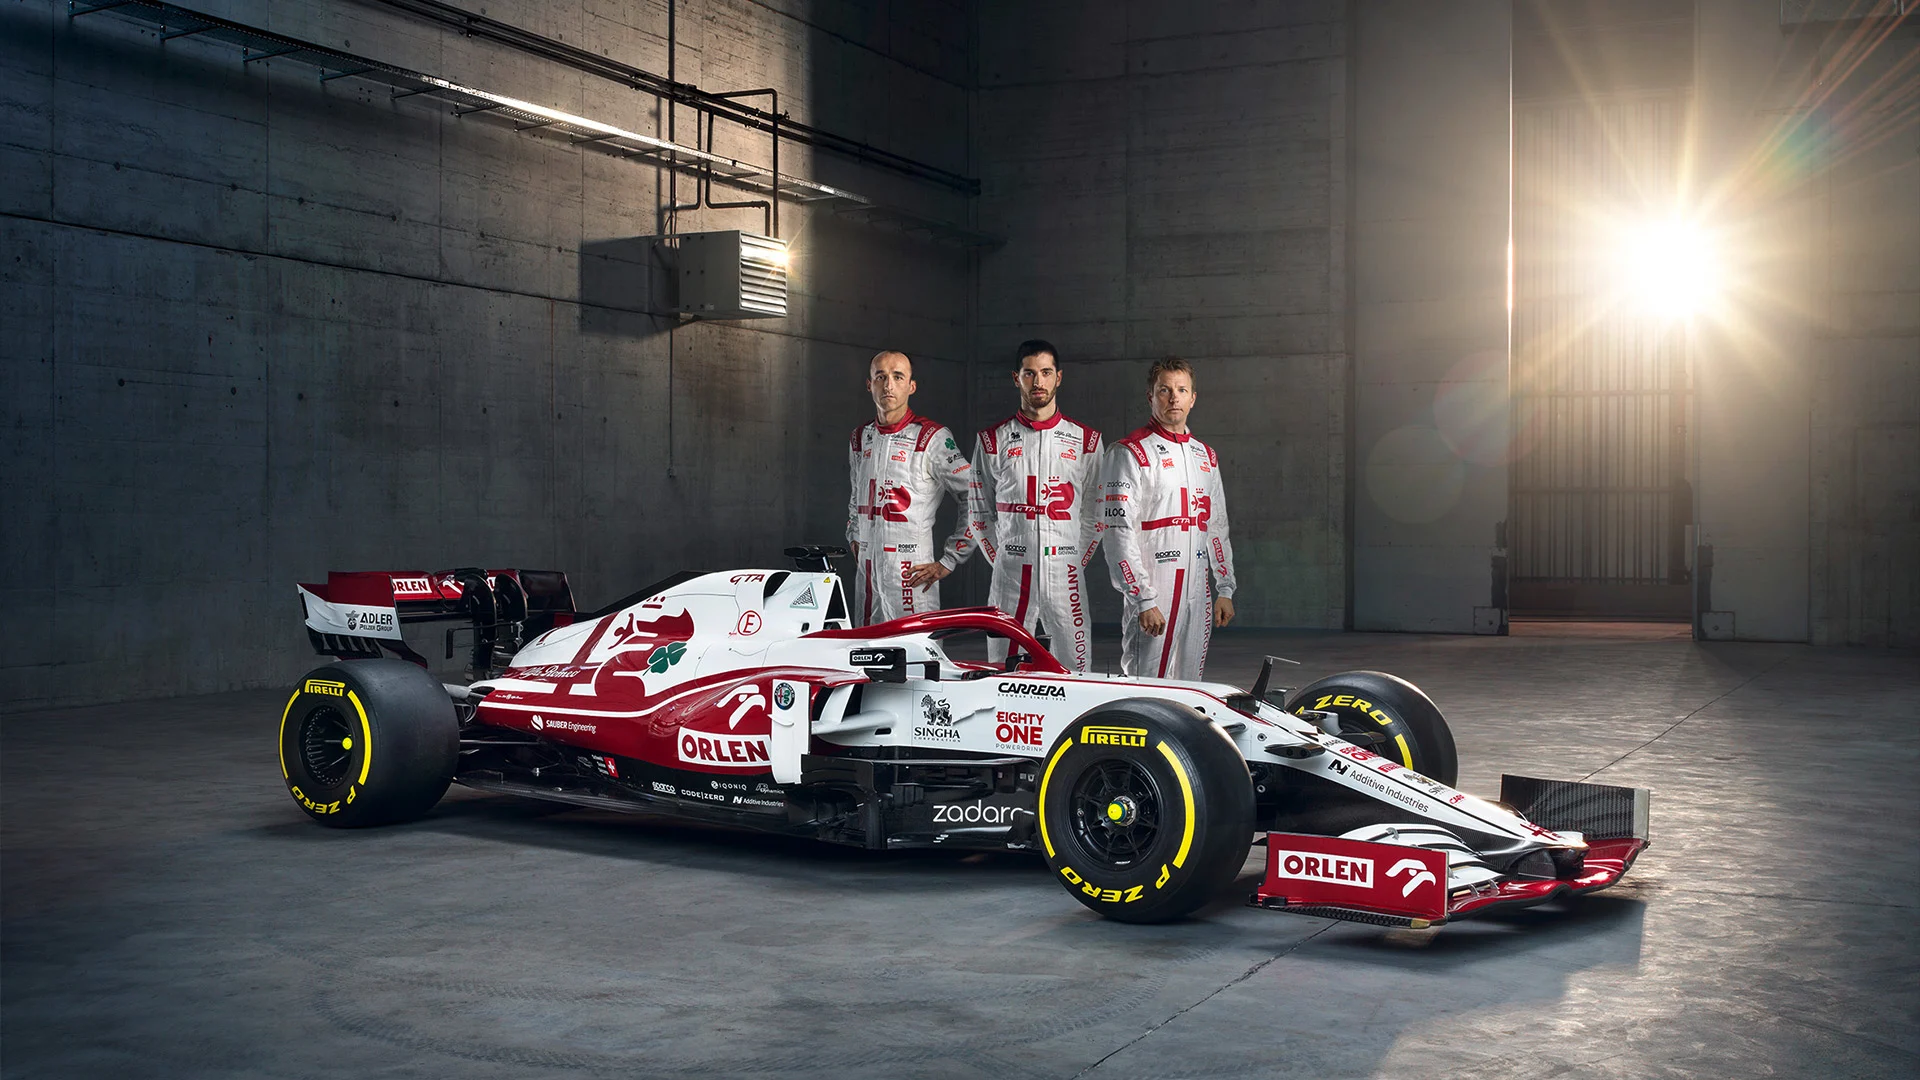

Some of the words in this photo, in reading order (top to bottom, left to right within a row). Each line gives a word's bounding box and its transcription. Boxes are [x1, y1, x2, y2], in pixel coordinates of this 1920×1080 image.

[1106, 481, 1131, 489] zadara
[1105, 508, 1126, 518] iLOQ
[982, 539, 996, 562] ORLE
[1005, 544, 1027, 553] sparco
[1155, 550, 1181, 559] sparco
[729, 573, 766, 586] GTA
[1119, 560, 1136, 584] ORLEN
[900, 560, 914, 614] ROBERT
[1067, 563, 1084, 628] ANTONIO
[360, 612, 393, 625] ADLER
[743, 614, 756, 634] E
[852, 654, 872, 662] ORLEN
[541, 665, 581, 678] Romeo
[304, 679, 346, 697] PIRELLI
[998, 682, 1066, 698] CARRERA
[996, 711, 1045, 725] EIGHTY
[1313, 694, 1393, 726] ZERO
[546, 719, 567, 729] SAUBER
[568, 721, 597, 735] Engineering
[914, 727, 960, 739] SINGHA
[995, 724, 1043, 746] ONE
[1080, 725, 1148, 747] PIRELLI
[681, 733, 771, 763] ORLEN
[995, 743, 1043, 752] POWERDRINK
[651, 781, 677, 794] sparco
[719, 783, 748, 791] IQONIQ
[1349, 769, 1385, 793] Additive
[1384, 785, 1430, 814] Industries
[291, 785, 341, 814] ZERO
[1155, 863, 1171, 890] P
[1283, 854, 1368, 883] ORLEN
[1060, 866, 1144, 903] ZERO
